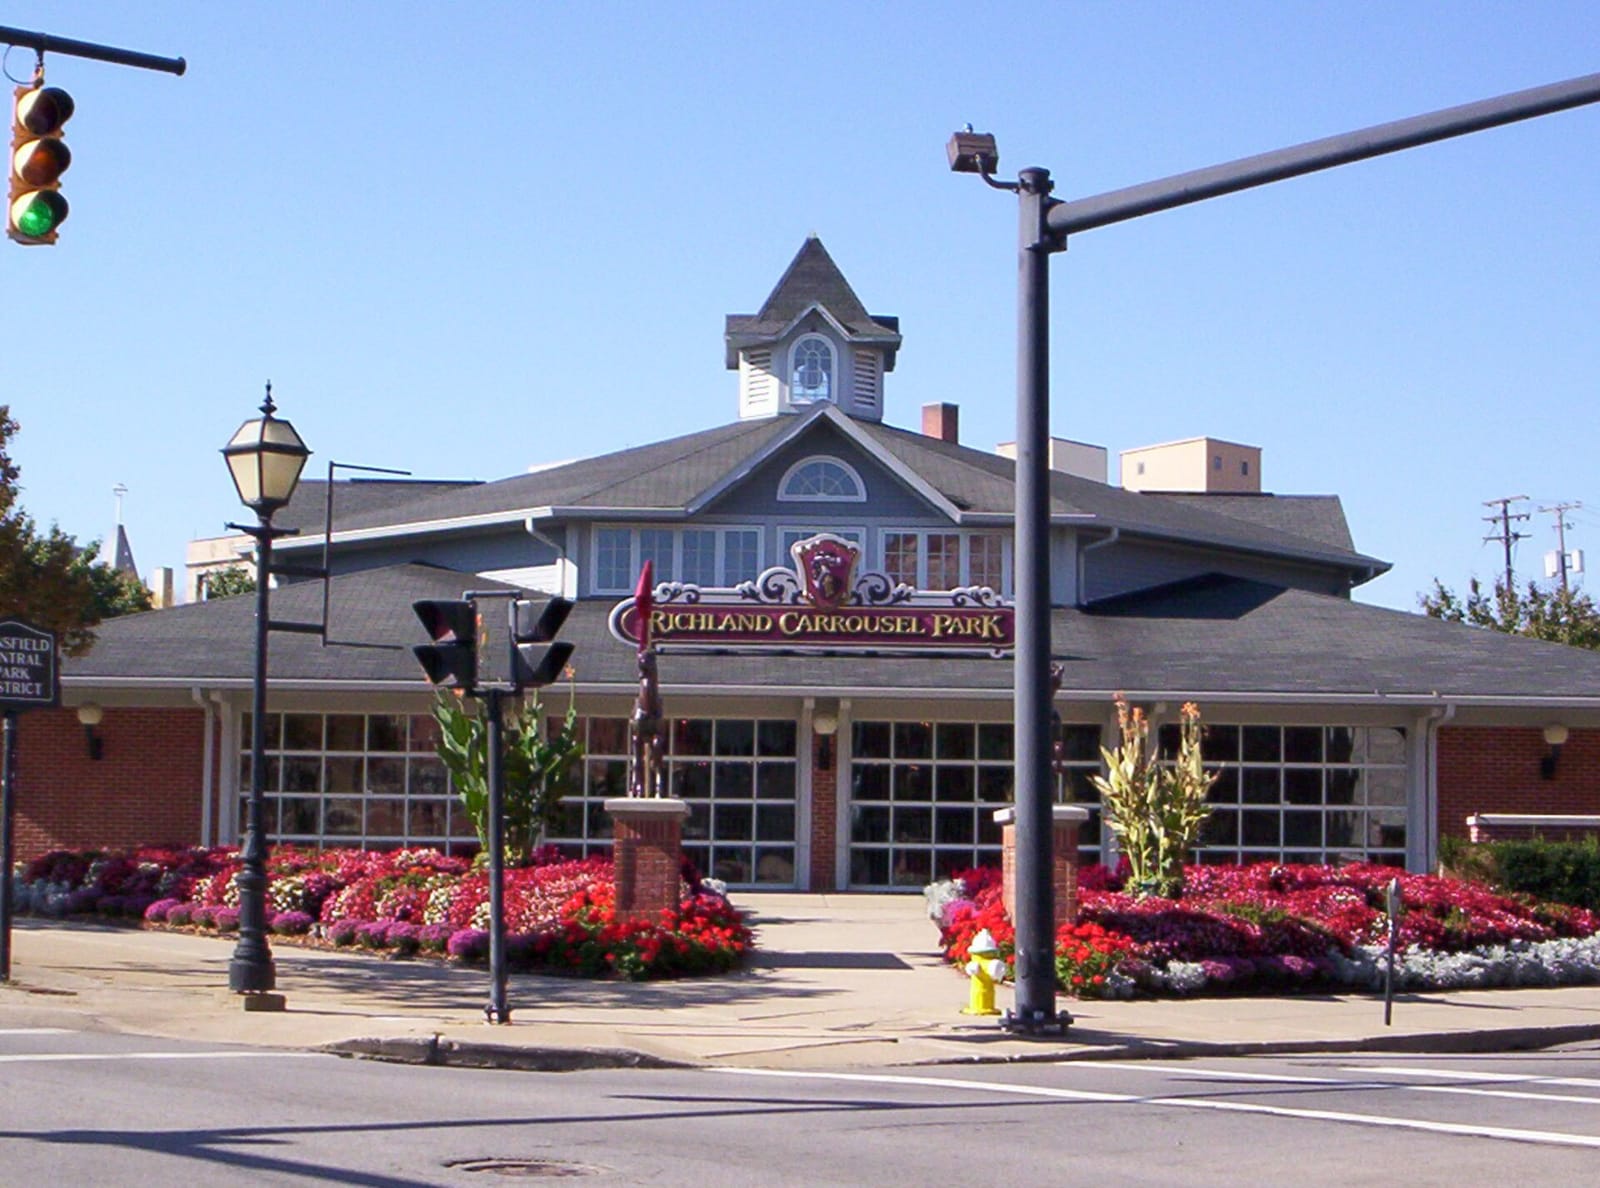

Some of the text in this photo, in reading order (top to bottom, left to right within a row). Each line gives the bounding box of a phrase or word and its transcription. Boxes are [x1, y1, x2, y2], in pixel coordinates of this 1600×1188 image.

[651, 610, 1004, 638] RICHLAND CARROUSEL PARK
[0, 636, 49, 651] SFIELD
[0, 667, 30, 679] ARK
